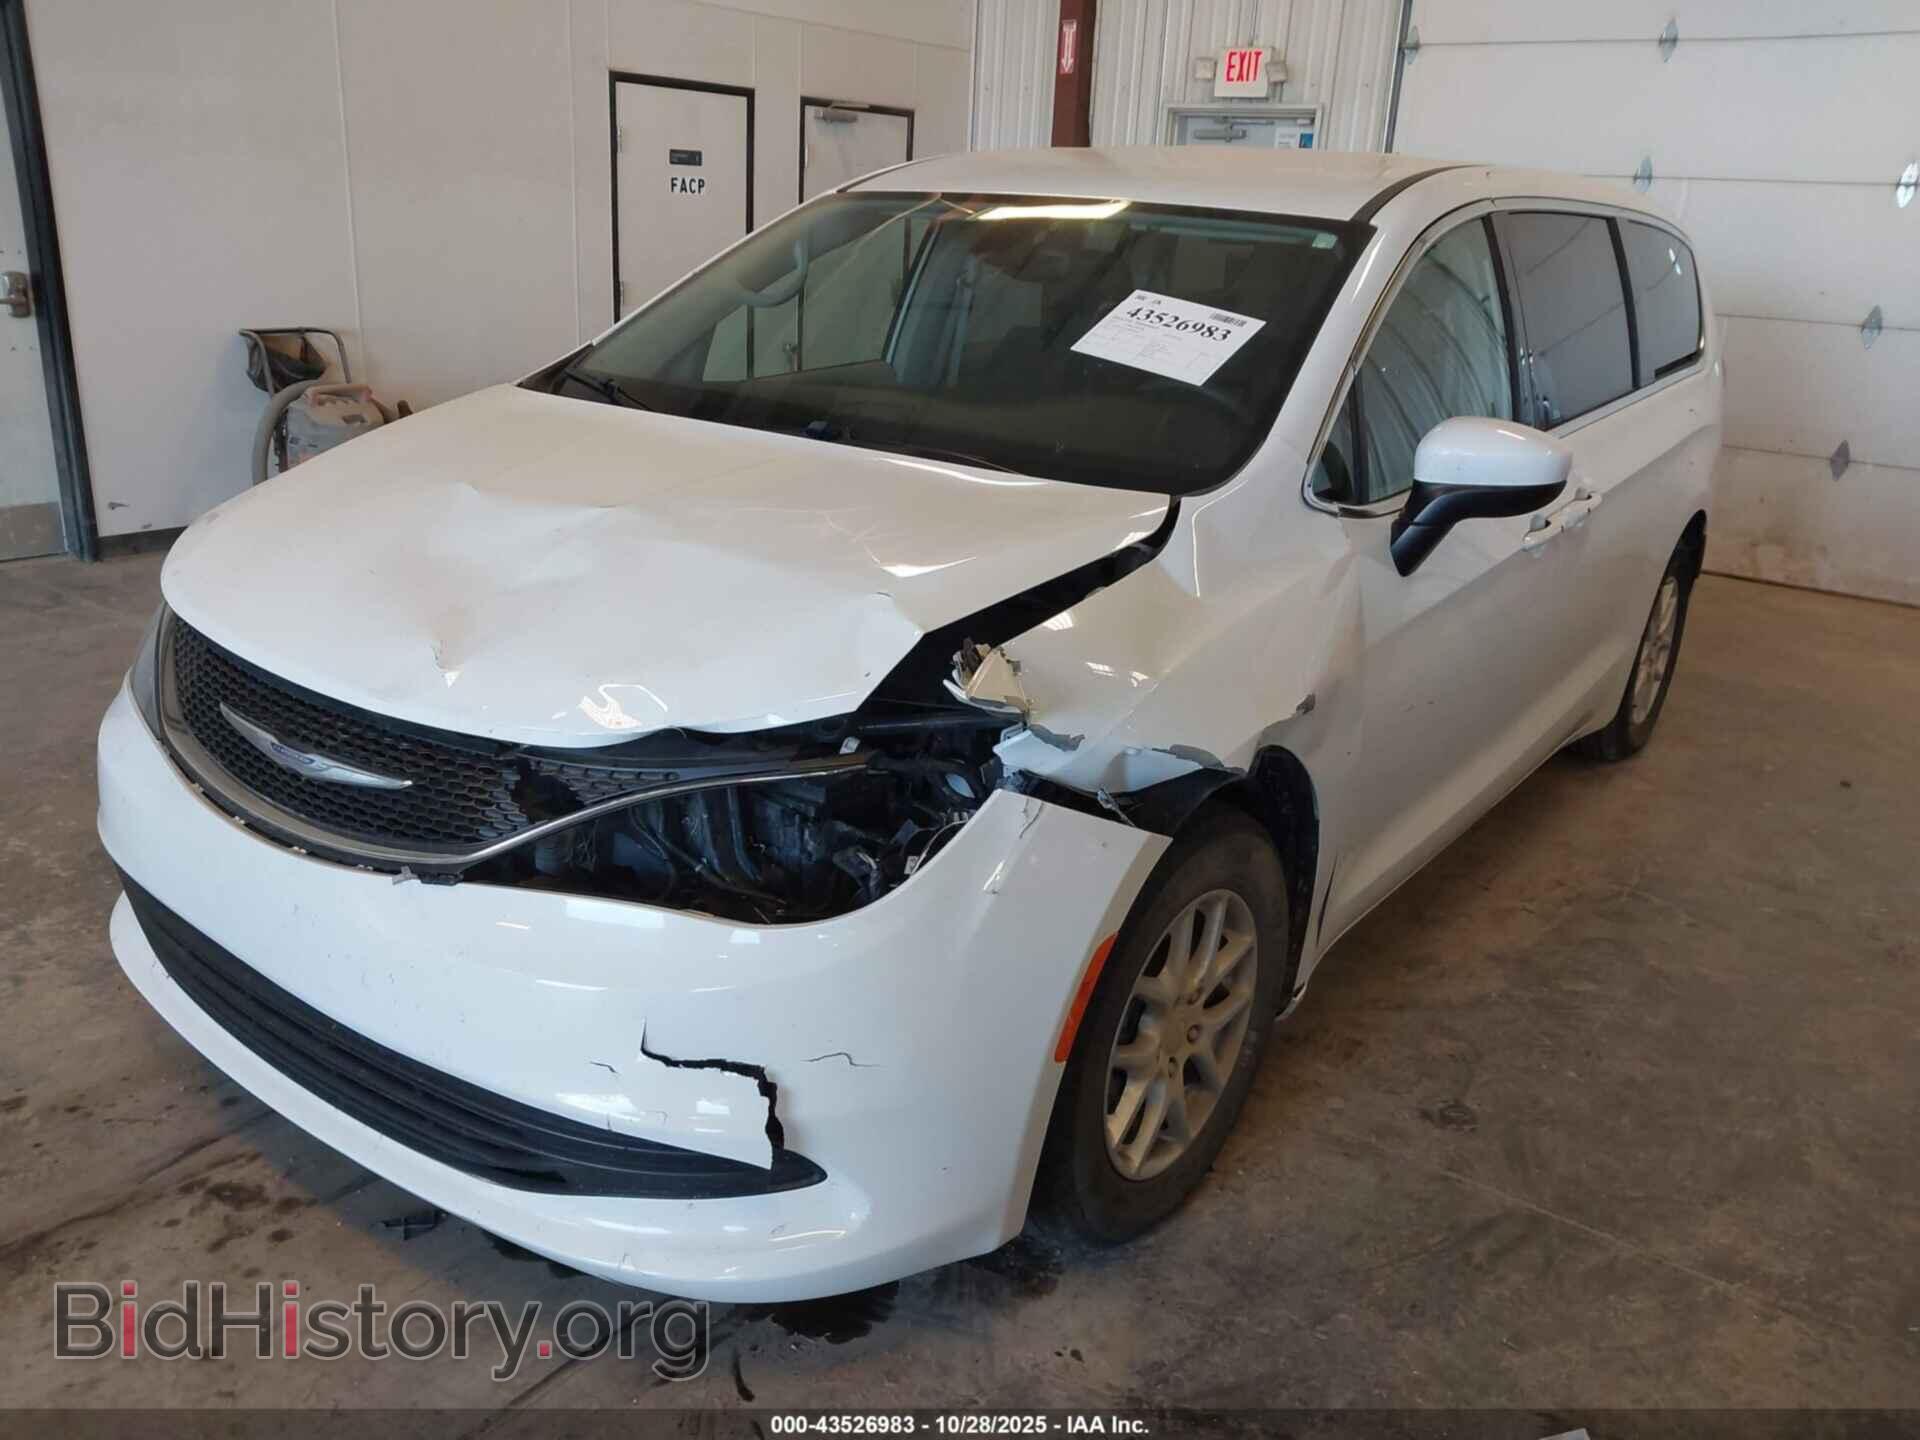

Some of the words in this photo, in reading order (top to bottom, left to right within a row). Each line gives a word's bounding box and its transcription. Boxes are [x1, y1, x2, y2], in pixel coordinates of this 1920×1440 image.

[1225, 48, 1263, 83] EXIT
[670, 176, 705, 194] FACP
[1126, 306, 1232, 342] 43526983
